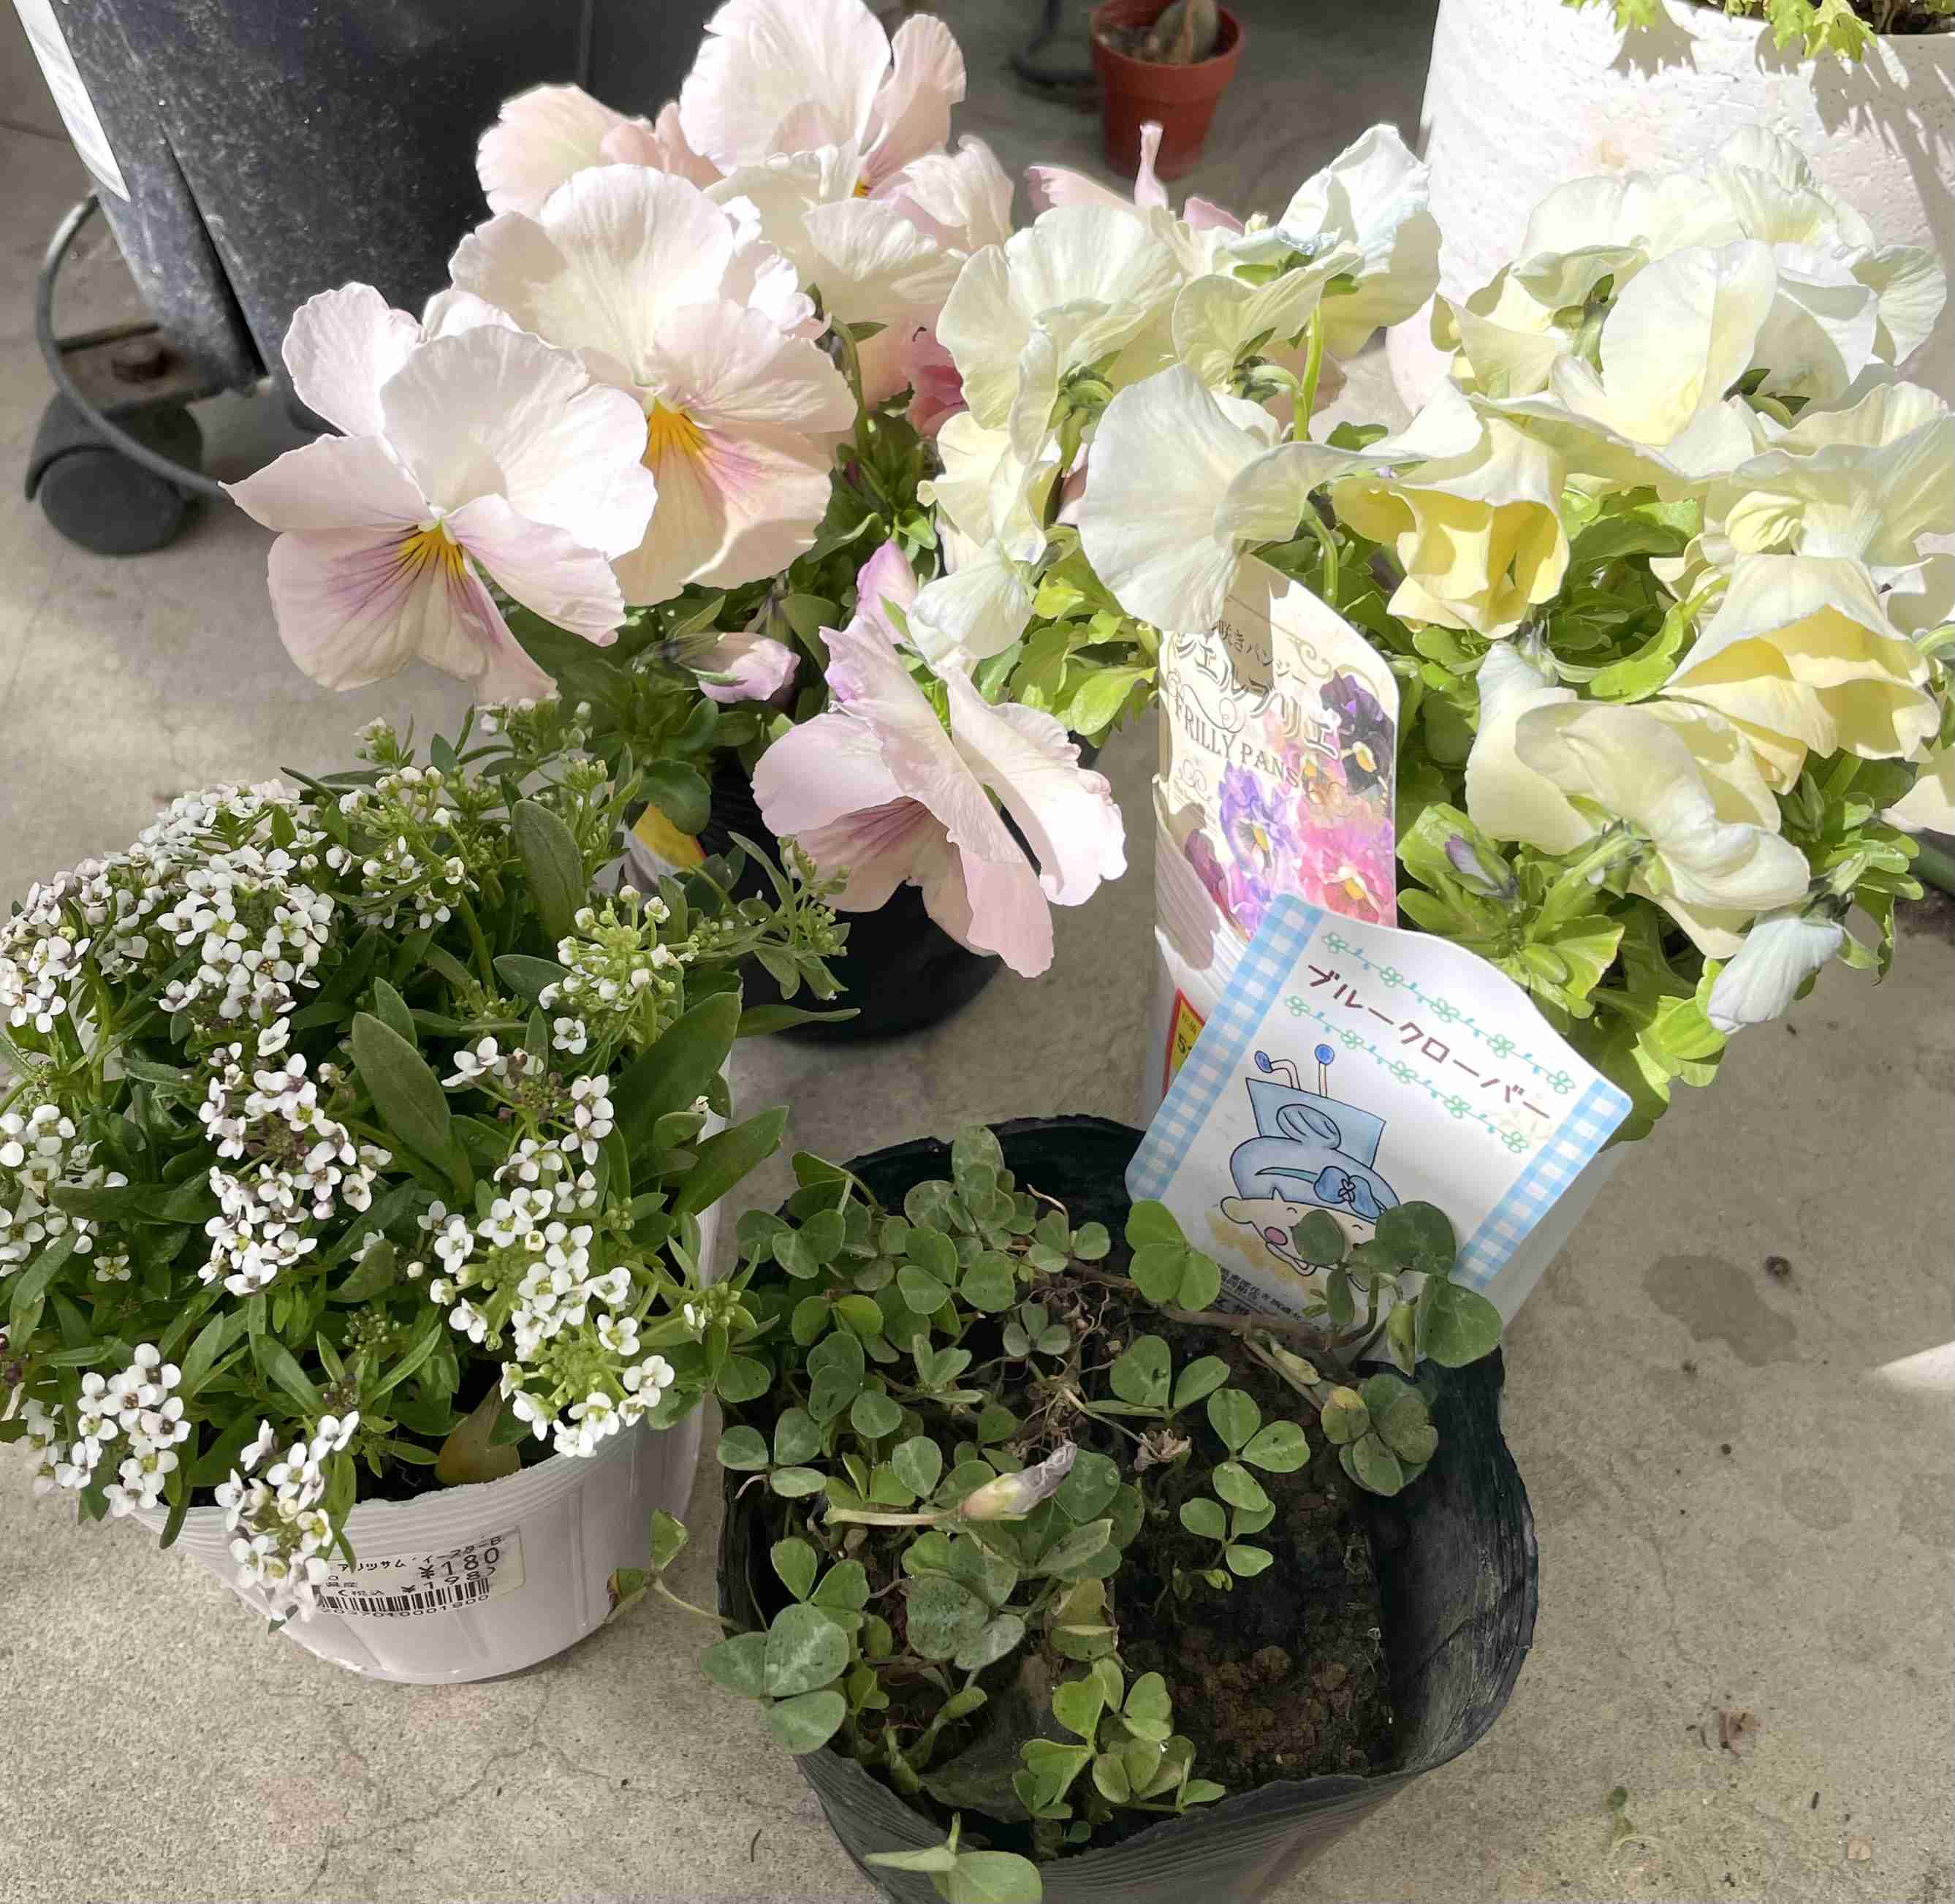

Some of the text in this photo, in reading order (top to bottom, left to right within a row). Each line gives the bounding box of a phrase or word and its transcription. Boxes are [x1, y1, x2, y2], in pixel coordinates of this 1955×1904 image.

[1240, 742, 1301, 788] PANS
[1307, 964, 1550, 1119] ブルークローバー
[418, 1547, 500, 1579] ¥180
